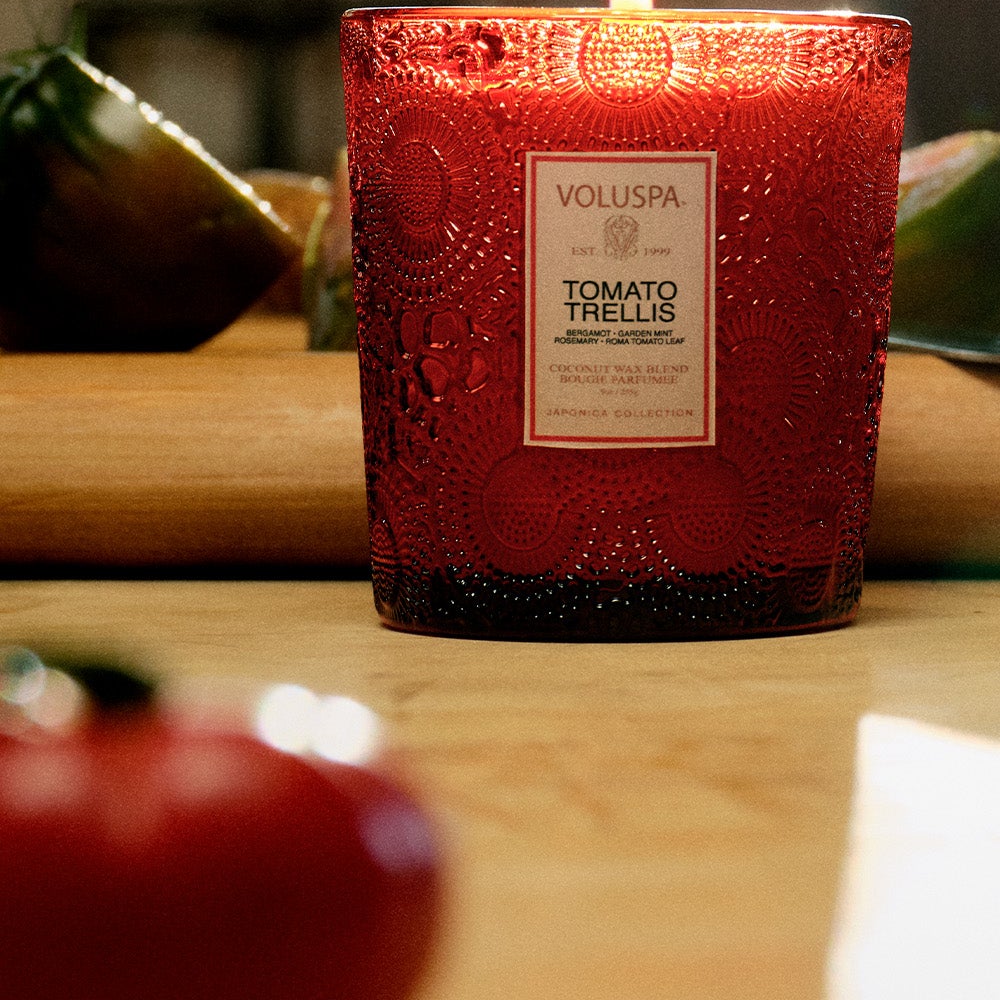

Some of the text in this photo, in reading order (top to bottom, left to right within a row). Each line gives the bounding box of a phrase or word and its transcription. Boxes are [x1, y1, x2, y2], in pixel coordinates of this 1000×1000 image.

[643, 247, 671, 256] 1999
[563, 280, 677, 300] TOMATO
[564, 302, 676, 323] TRELLIS
[566, 329, 673, 337] BERGAMOT GARDEN MINT
[554, 337, 685, 345] ROSEMARY ROMA TOMATO LEAF
[549, 363, 689, 374] COCONUT WAX BLEND
[560, 375, 607, 385] BOUGIE
[546, 408, 694, 418] JAPONICA COLLECTION
